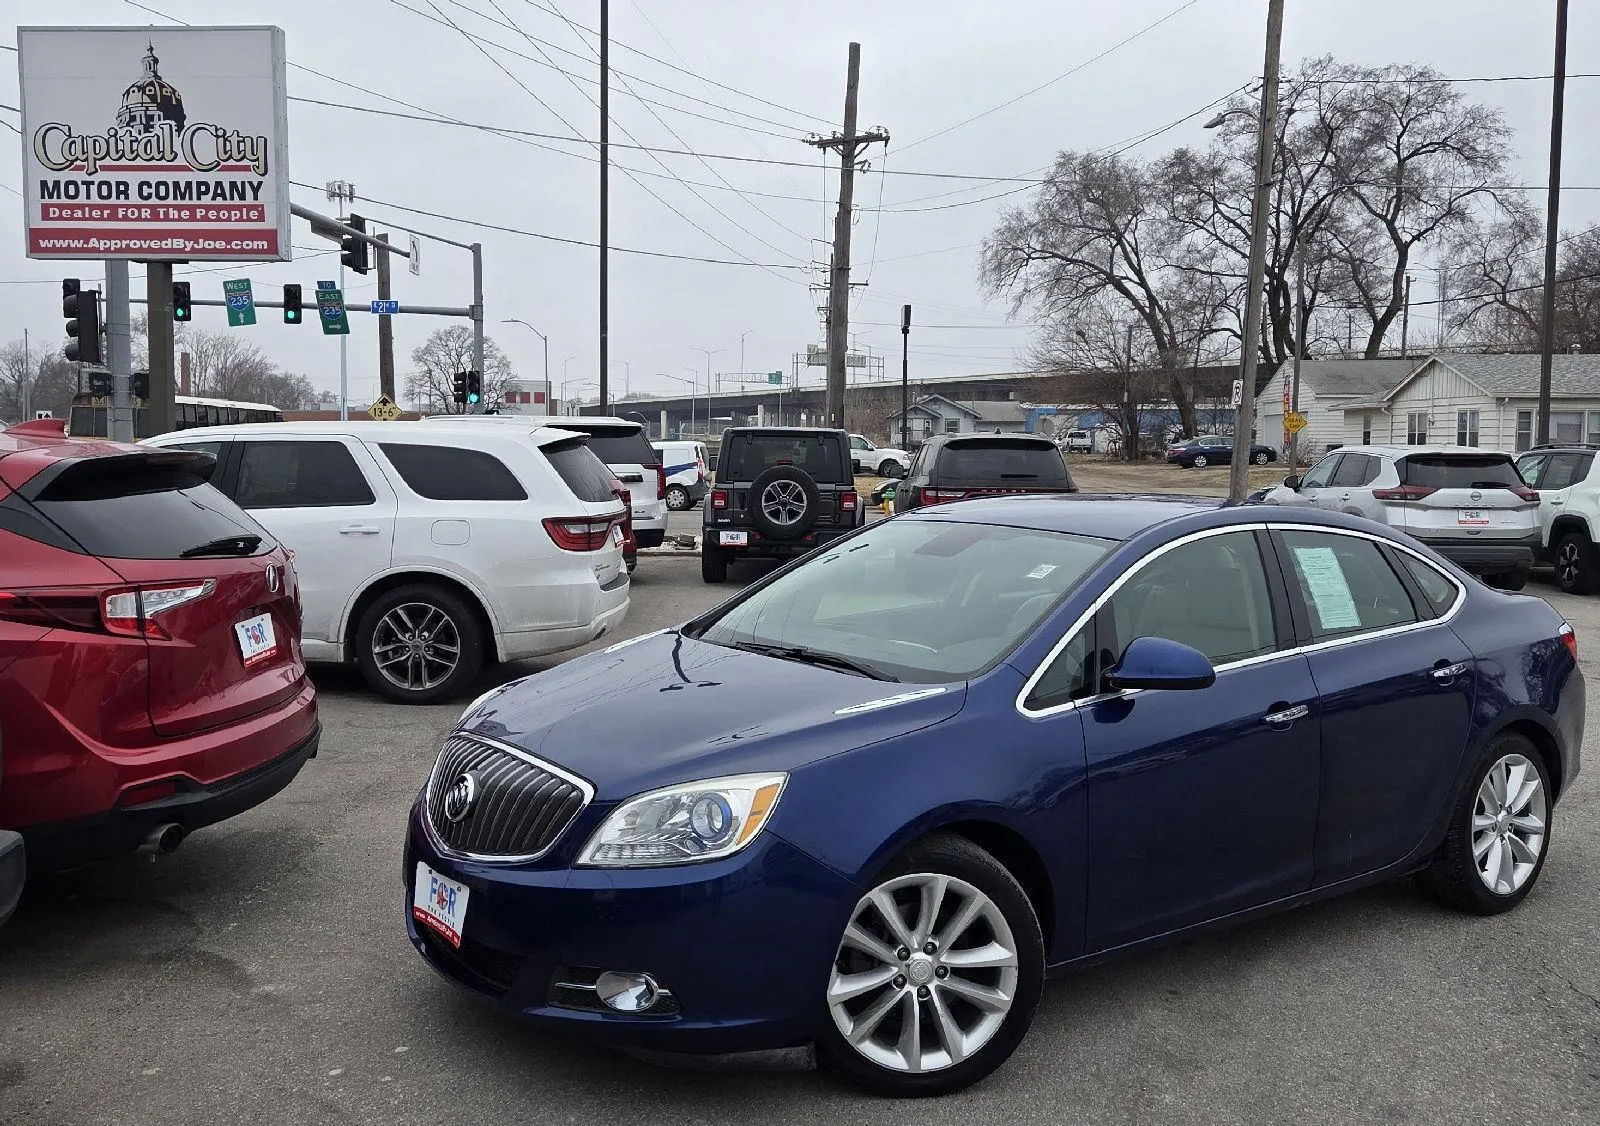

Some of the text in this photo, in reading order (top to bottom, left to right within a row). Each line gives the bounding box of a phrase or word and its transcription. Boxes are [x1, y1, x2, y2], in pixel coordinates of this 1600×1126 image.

[34, 122, 268, 176] Capital City
[40, 180, 263, 201] MOTOR COMPANY
[49, 207, 259, 221] Dealer FOR The People
[39, 238, 268, 250] www.ApprovedByJoe.com
[225, 281, 248, 290] WEST
[230, 295, 248, 306] 235
[319, 292, 339, 300] EAST
[323, 305, 341, 315] 235
[245, 622, 267, 647] FOR
[429, 876, 457, 918] FOR
